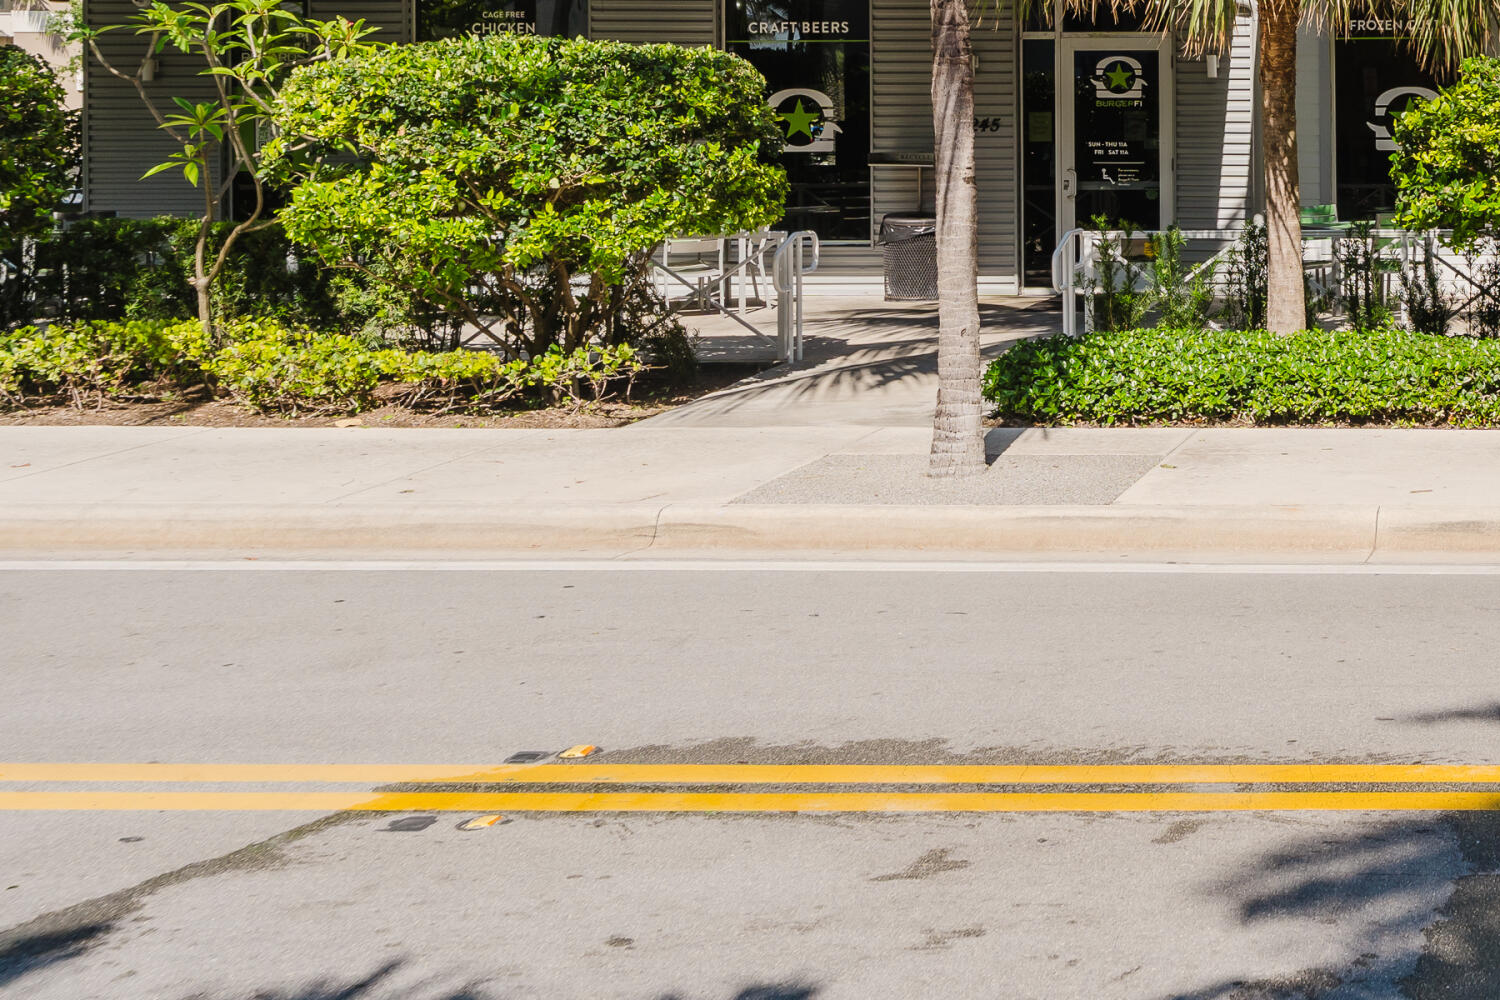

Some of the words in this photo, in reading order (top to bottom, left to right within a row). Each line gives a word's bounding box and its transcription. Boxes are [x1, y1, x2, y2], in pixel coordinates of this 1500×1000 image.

[482, 10, 503, 19] CAGE
[505, 10, 526, 19] FREE
[471, 22, 537, 34] CHICKEN
[748, 21, 797, 34] CRAFT
[802, 21, 850, 34] BEERS
[1349, 19, 1402, 31] FROZEN
